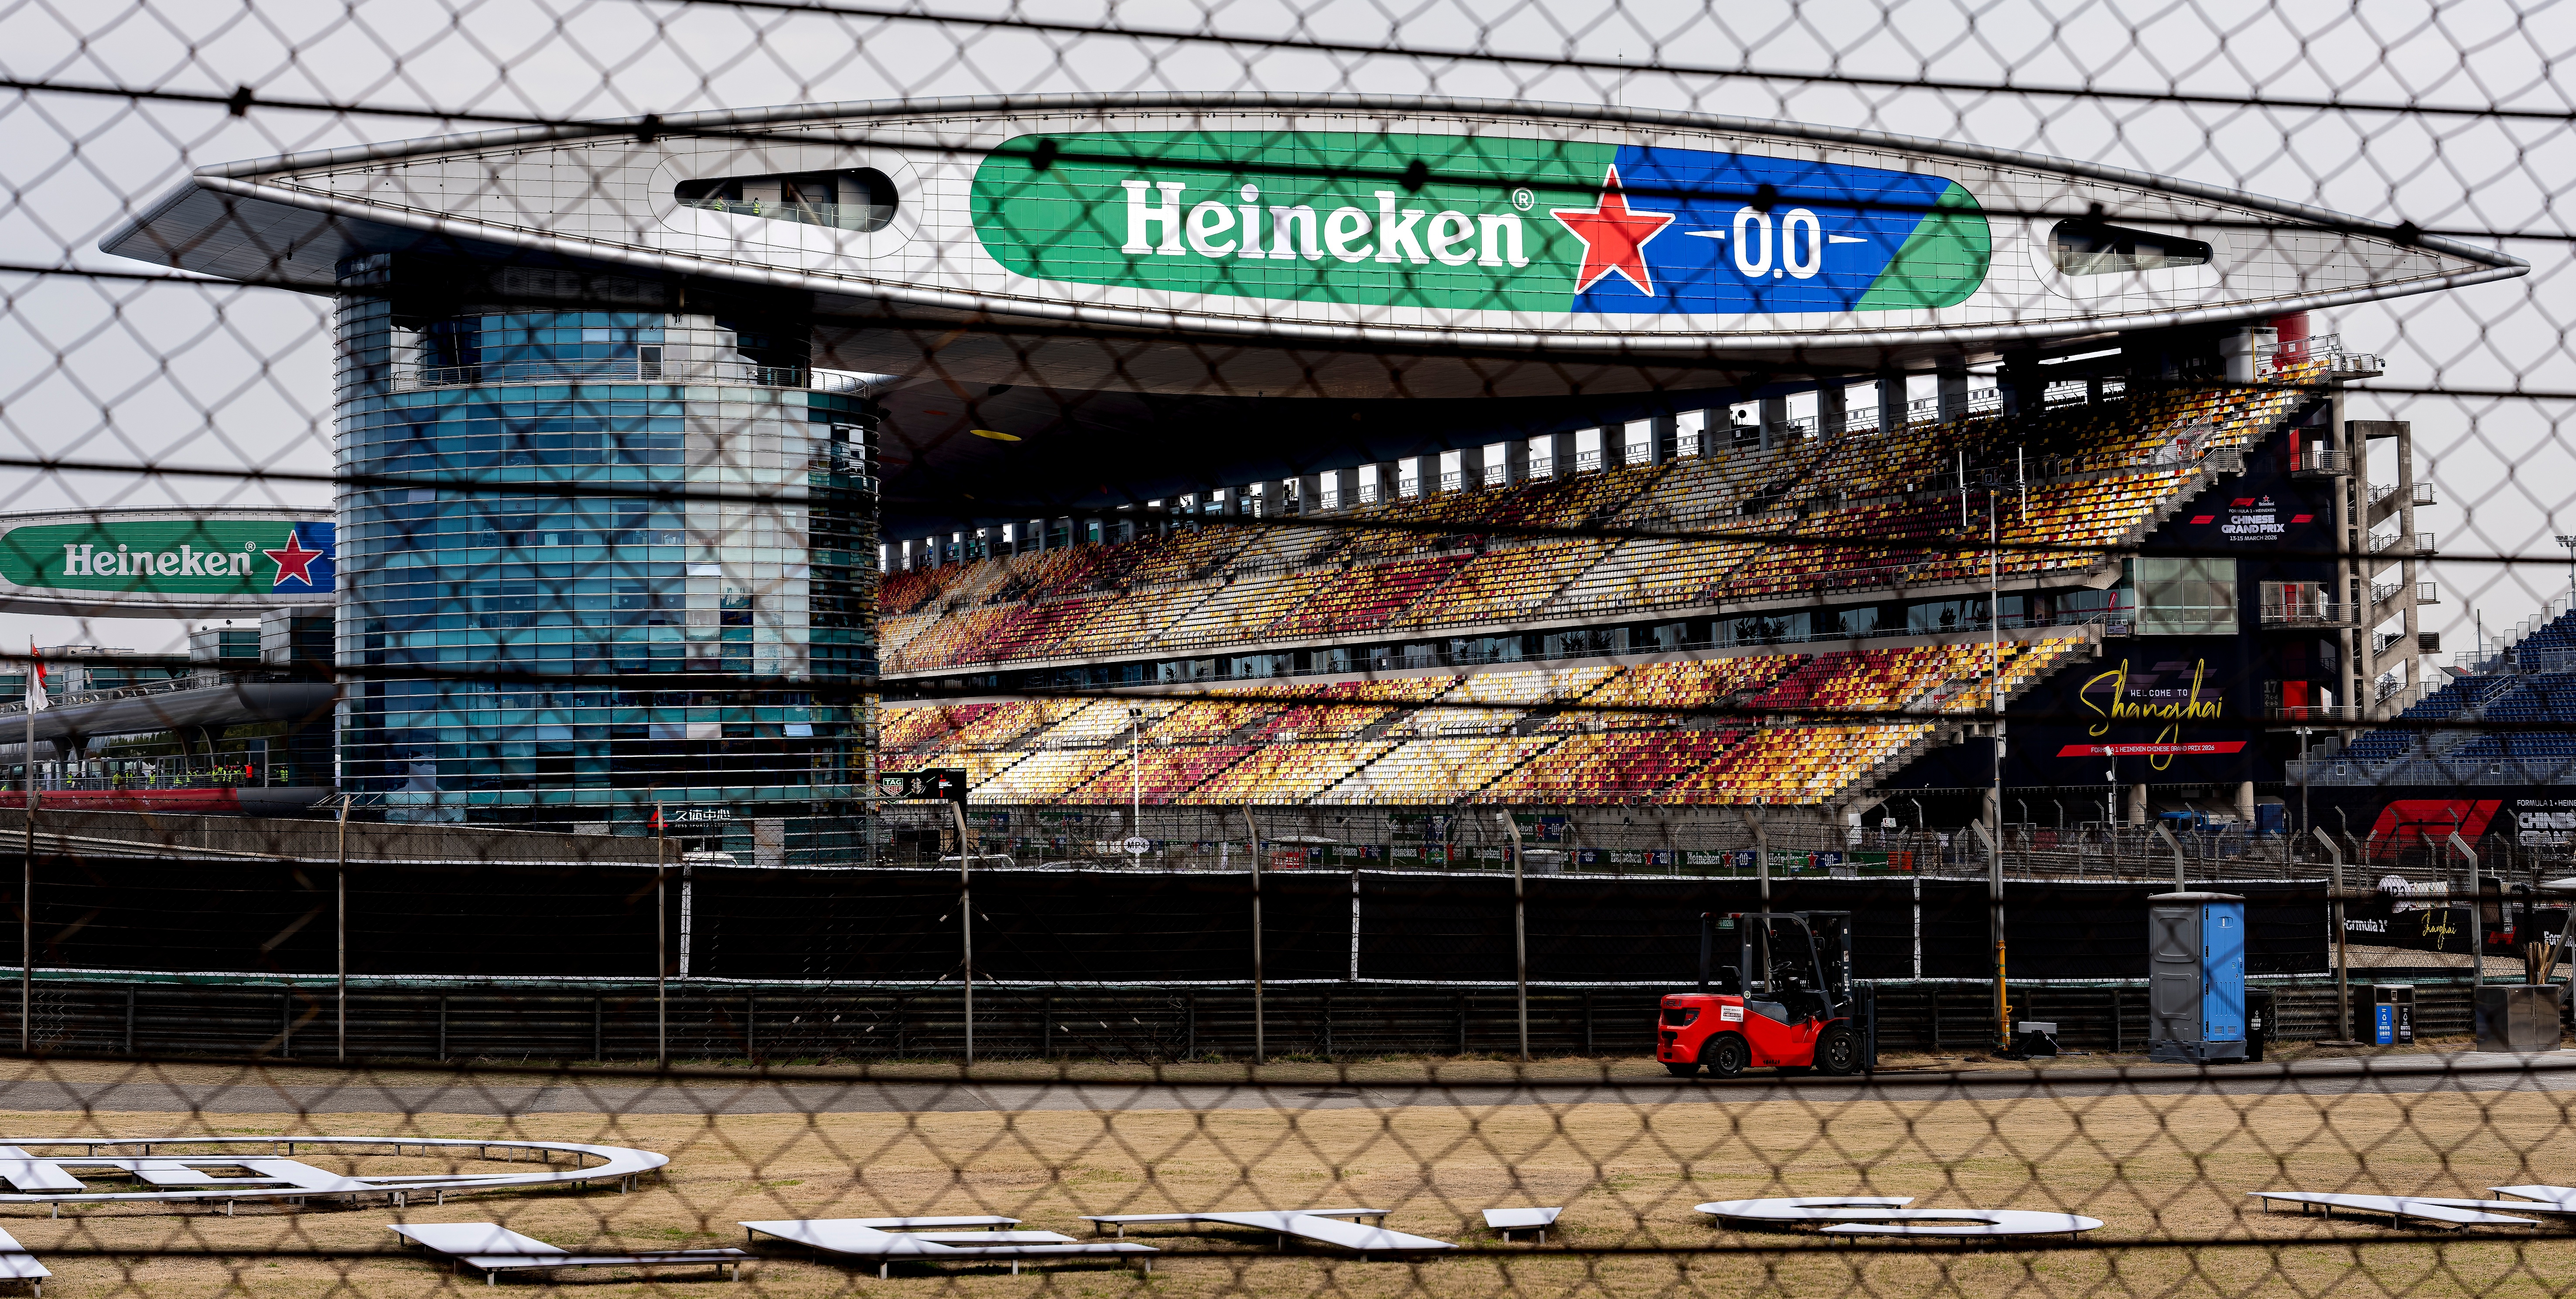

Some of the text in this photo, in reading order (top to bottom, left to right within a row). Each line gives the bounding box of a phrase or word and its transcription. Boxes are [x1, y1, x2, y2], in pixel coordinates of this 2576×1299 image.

[1733, 205, 1821, 279] 0.0
[2231, 515, 2275, 524] CHINESE
[2221, 524, 2285, 533] GRAND PRIX
[2264, 681, 2277, 693] 17
[2080, 658, 2223, 771] Shanghai
[2344, 917, 2378, 932] ormula
